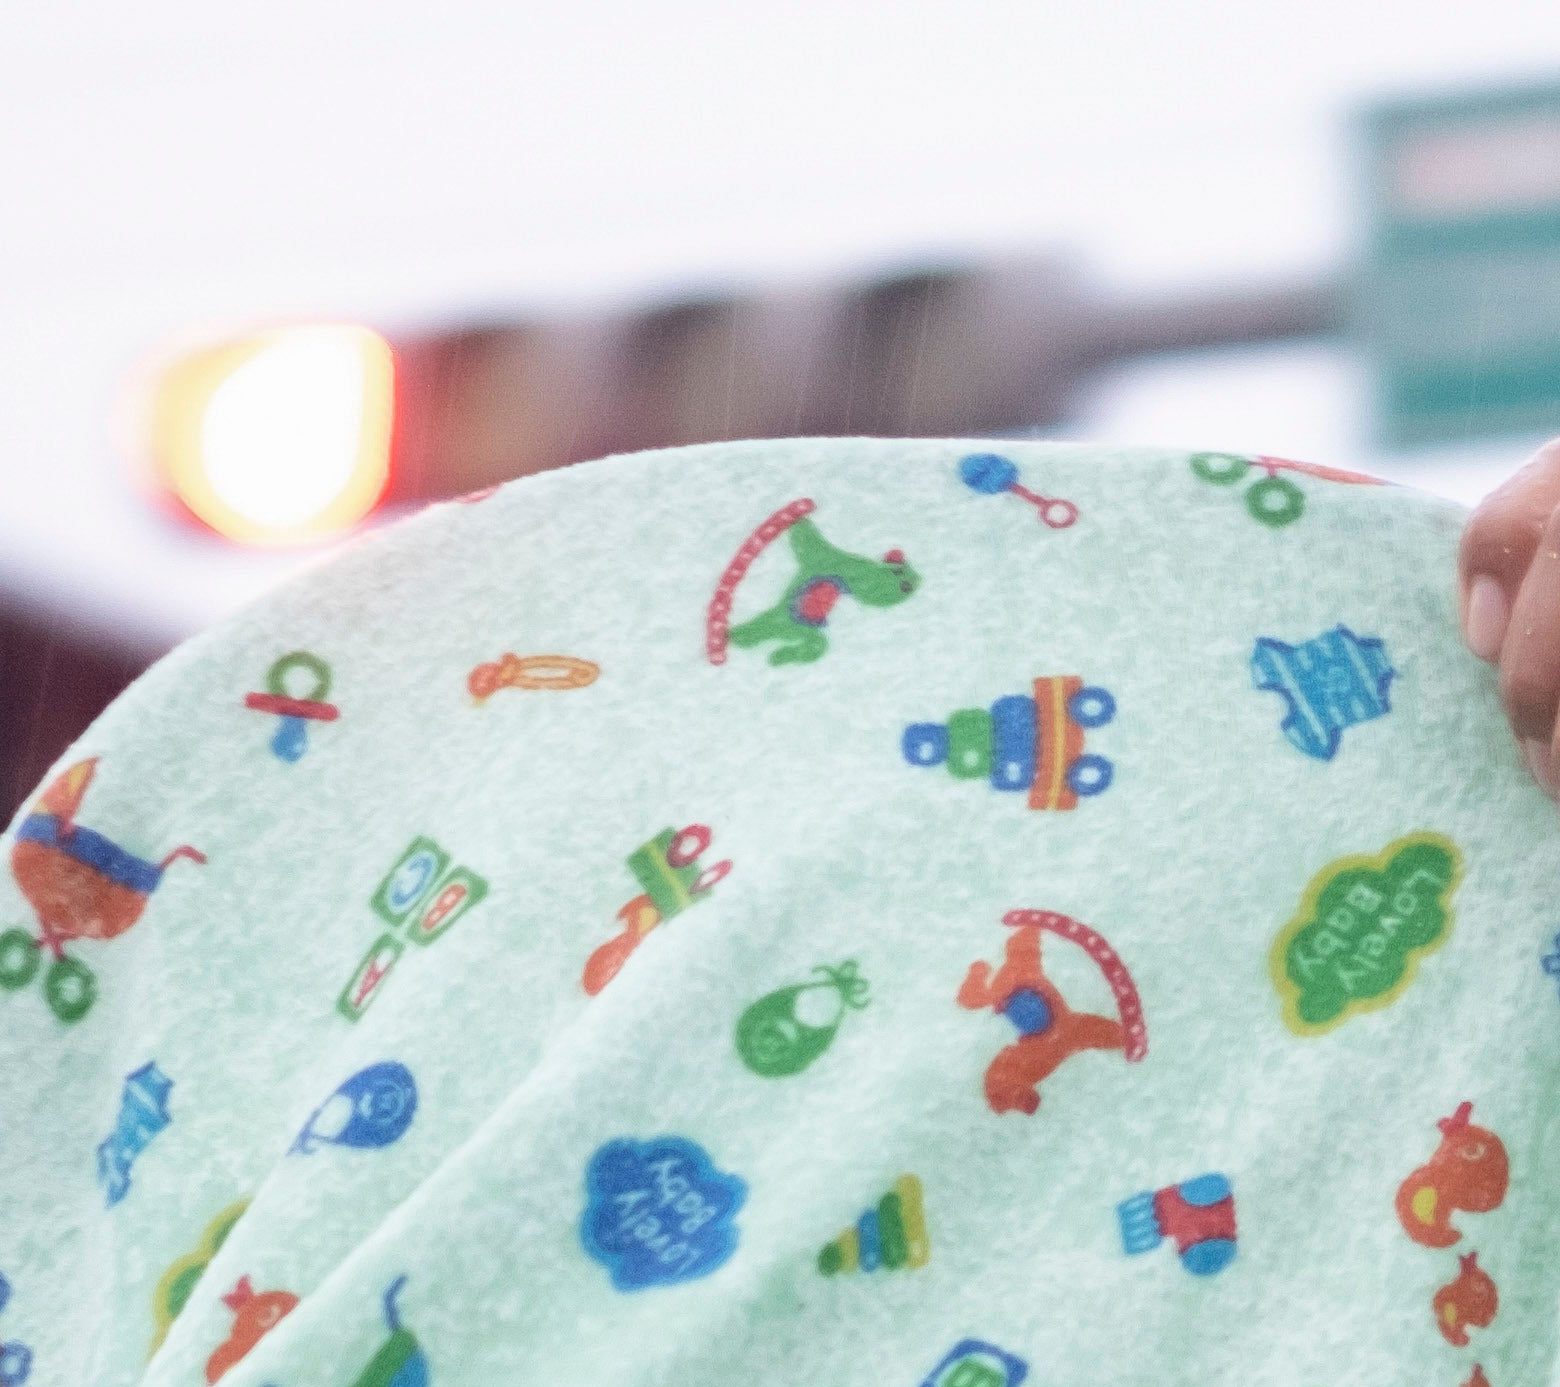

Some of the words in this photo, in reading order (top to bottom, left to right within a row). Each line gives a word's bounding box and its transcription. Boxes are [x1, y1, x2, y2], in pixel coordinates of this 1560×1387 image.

[1295, 883, 1384, 982] Baby
[1336, 869, 1441, 991] Lovely
[613, 1188, 700, 1276] Lovely
[647, 1159, 718, 1234] Baby
